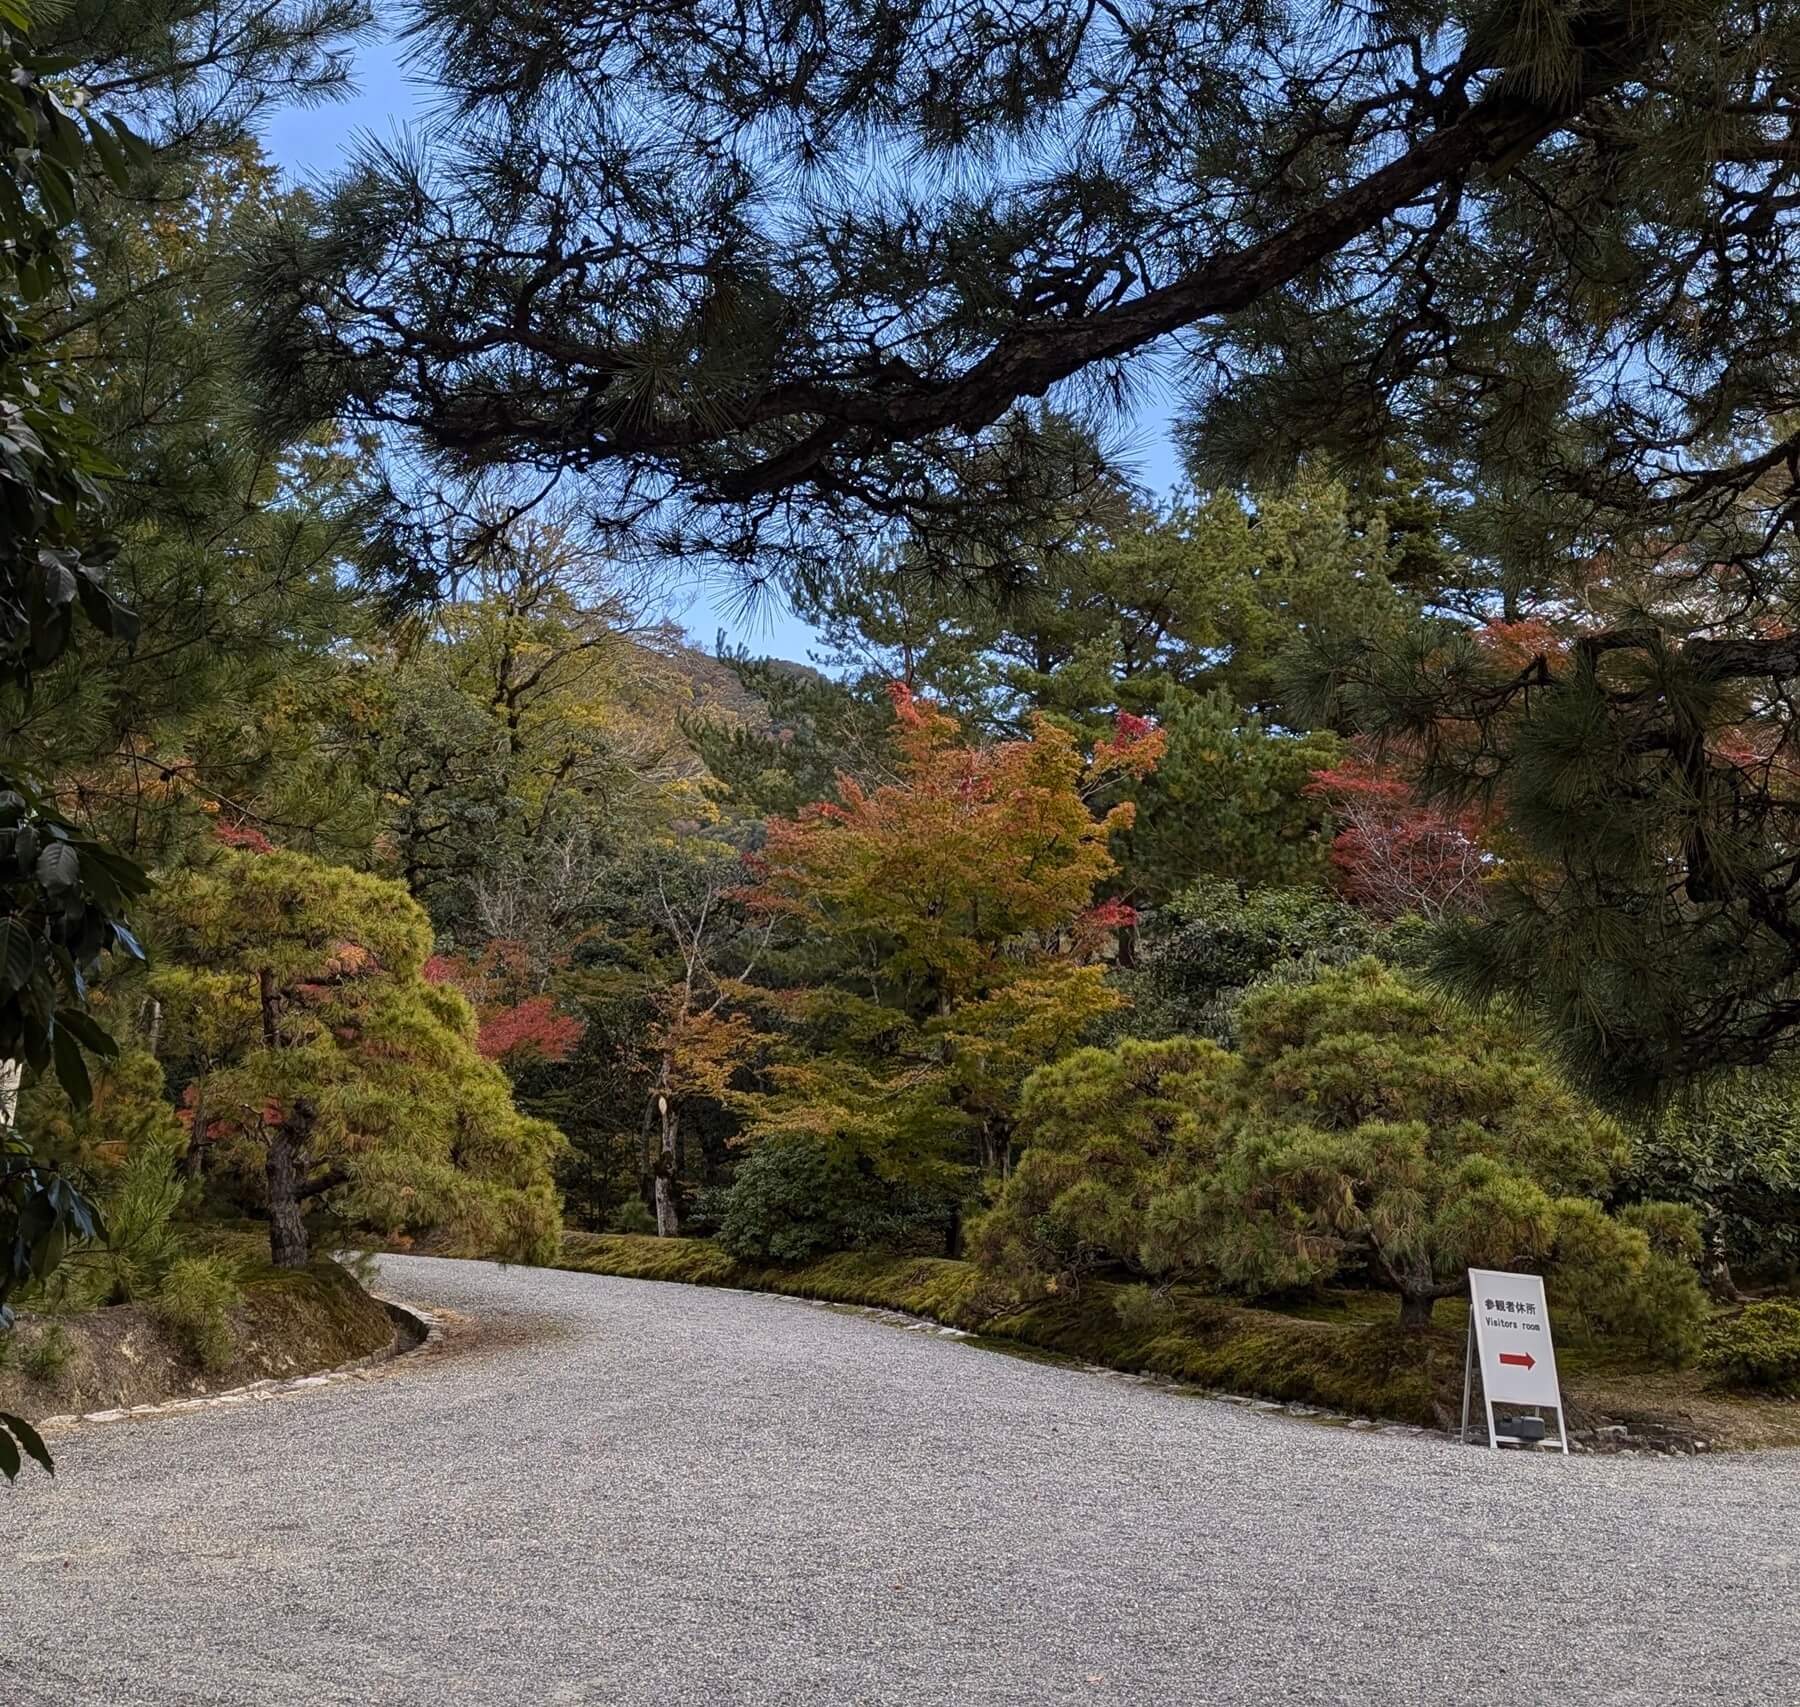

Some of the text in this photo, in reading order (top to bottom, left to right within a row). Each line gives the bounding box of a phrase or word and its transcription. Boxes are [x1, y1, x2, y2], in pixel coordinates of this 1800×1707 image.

[1484, 1299, 1536, 1315] 参観者休所
[1485, 1316, 1541, 1331] Visitors room
